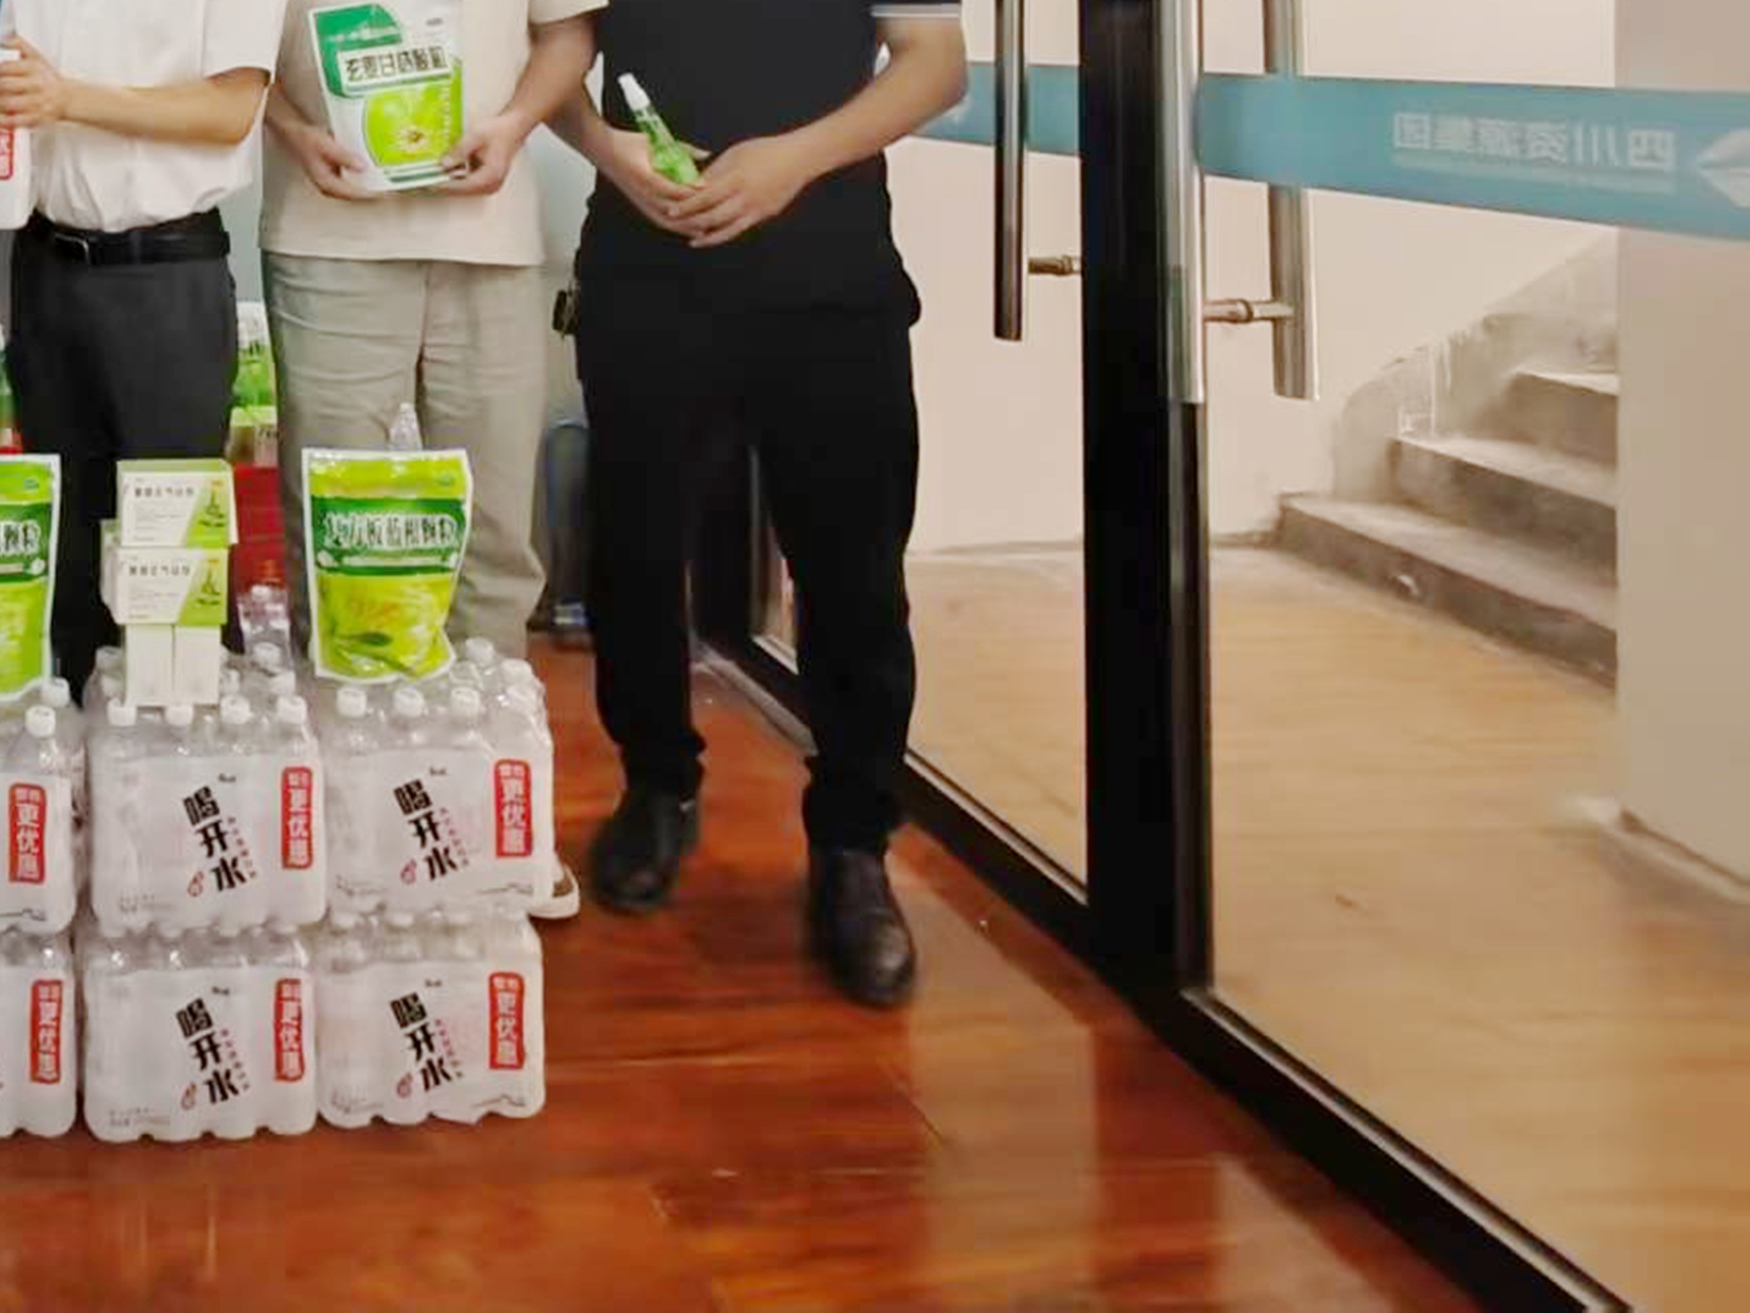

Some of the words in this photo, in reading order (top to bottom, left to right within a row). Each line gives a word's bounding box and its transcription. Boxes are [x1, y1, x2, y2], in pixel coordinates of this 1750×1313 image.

[183, 785, 247, 892] 喝开水
[393, 779, 458, 881] 喝开水
[176, 998, 240, 1104] 喝开水
[390, 992, 452, 1092] 喝开水
